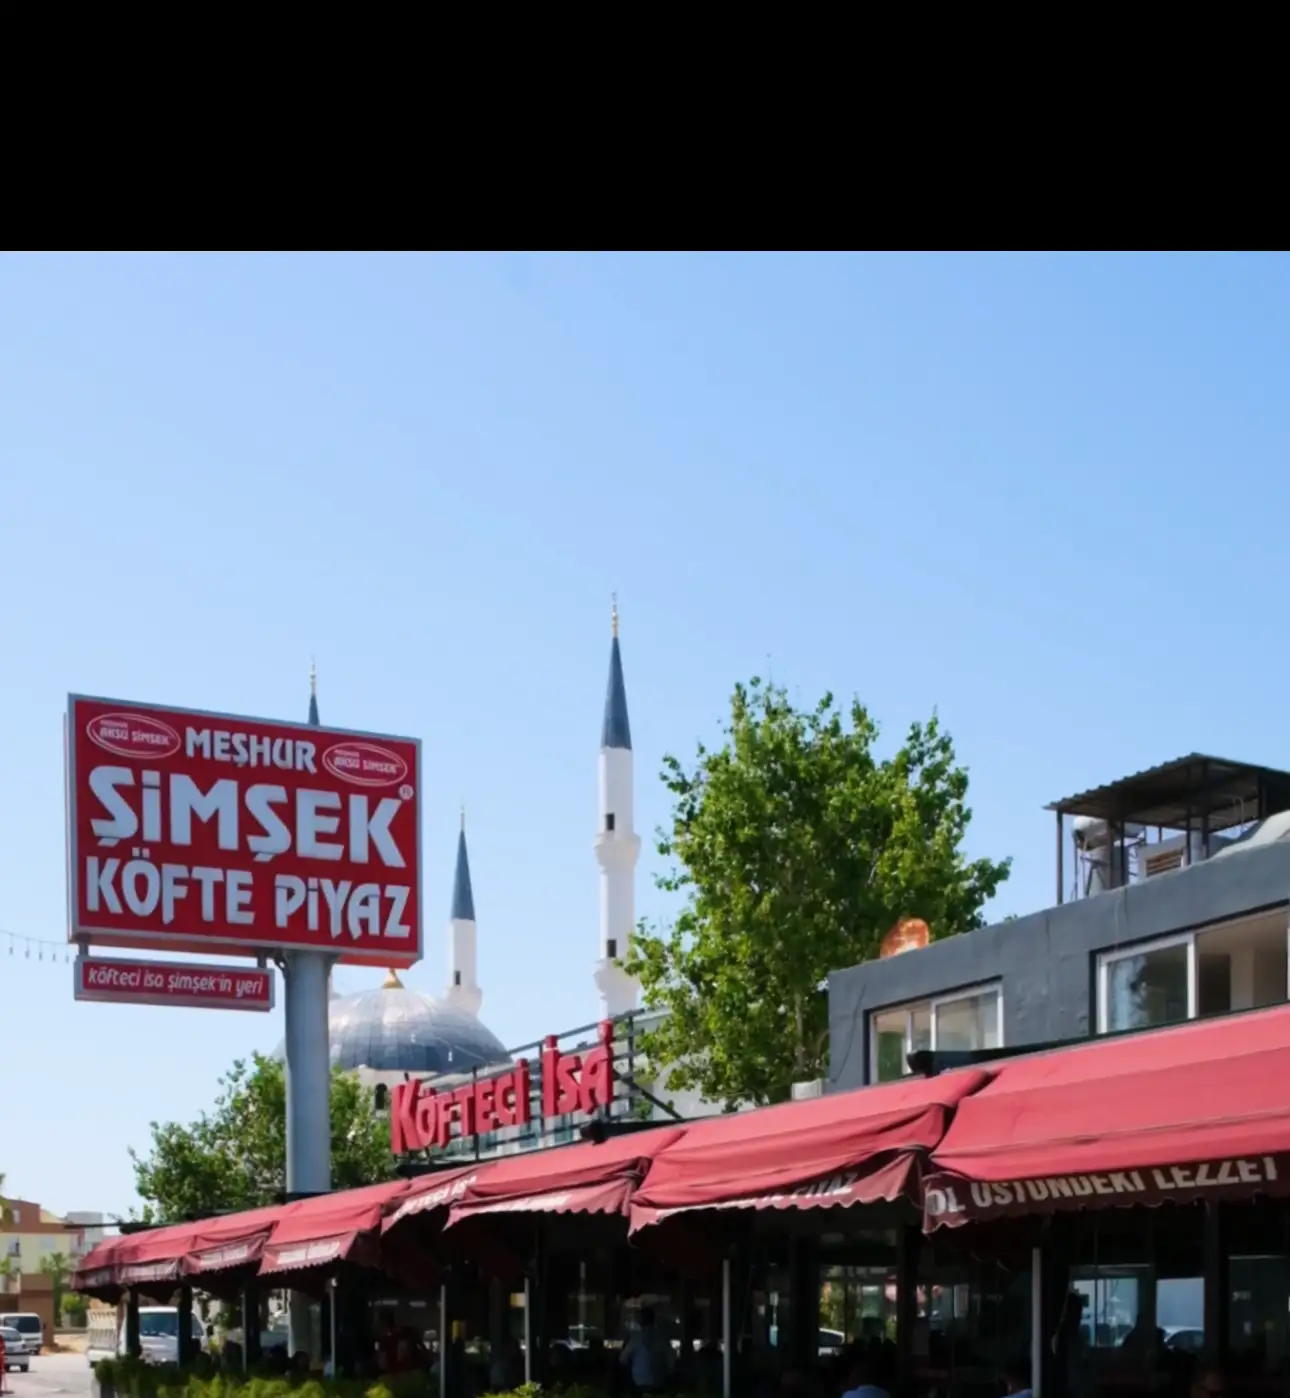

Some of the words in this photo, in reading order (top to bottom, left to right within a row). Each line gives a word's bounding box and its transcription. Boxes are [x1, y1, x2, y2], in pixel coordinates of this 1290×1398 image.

[185, 726, 318, 774] MEŞHUR
[86, 847, 255, 925] KÖFTE
[88, 966, 142, 987] köfteci
[143, 972, 165, 988] isa
[235, 976, 264, 998] yeri
